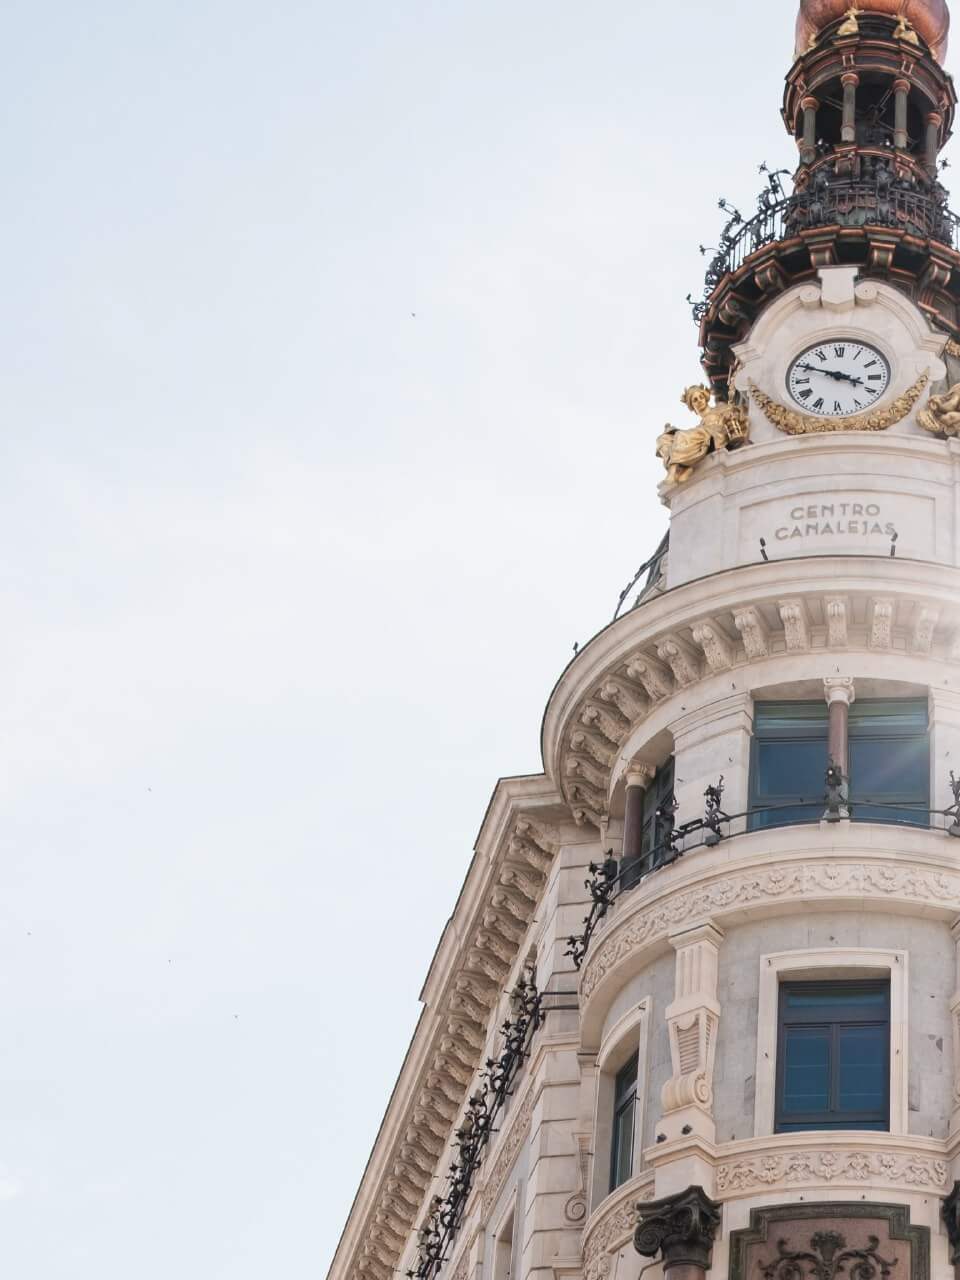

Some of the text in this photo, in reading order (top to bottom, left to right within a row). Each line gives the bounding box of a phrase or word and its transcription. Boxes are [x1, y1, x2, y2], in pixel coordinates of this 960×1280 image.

[853, 350, 862, 361] I
[790, 503, 881, 521] CENTRO
[775, 520, 897, 541] CANALEJAS
